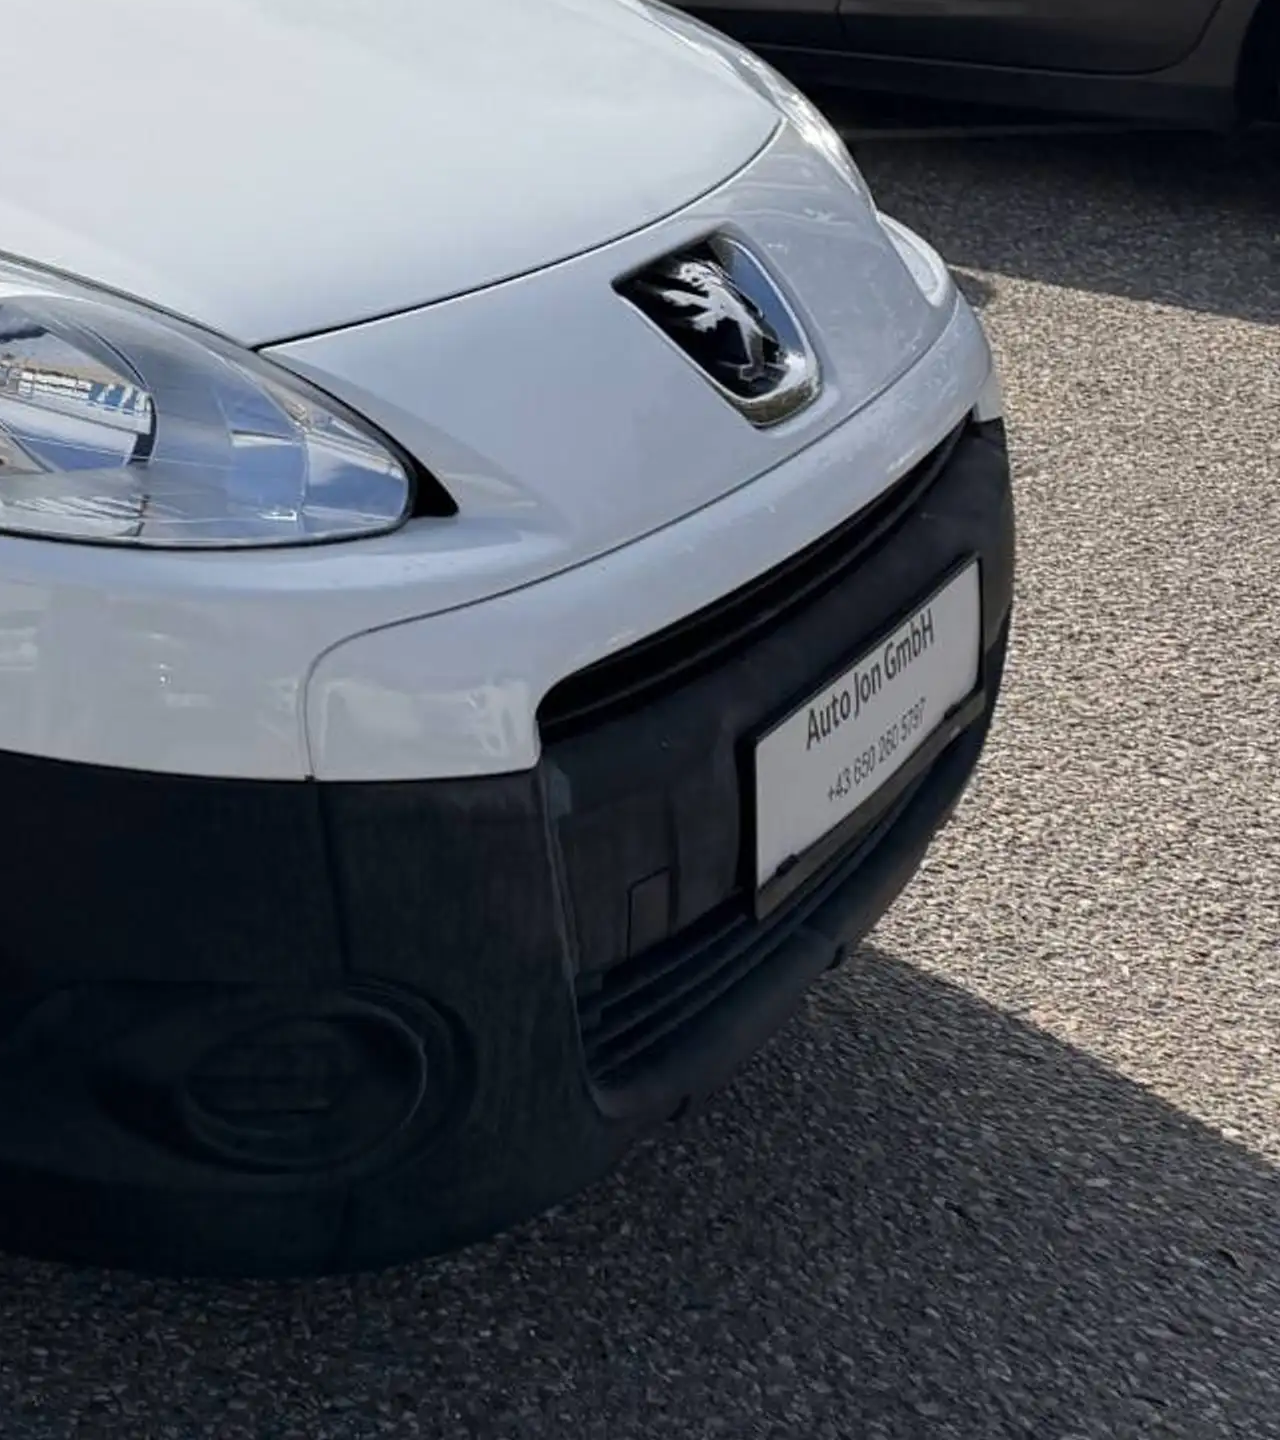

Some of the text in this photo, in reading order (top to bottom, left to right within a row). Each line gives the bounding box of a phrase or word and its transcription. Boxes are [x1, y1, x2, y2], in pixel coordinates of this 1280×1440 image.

[806, 607, 935, 751] Auto Jon GmbH
[827, 767, 851, 802] +43
